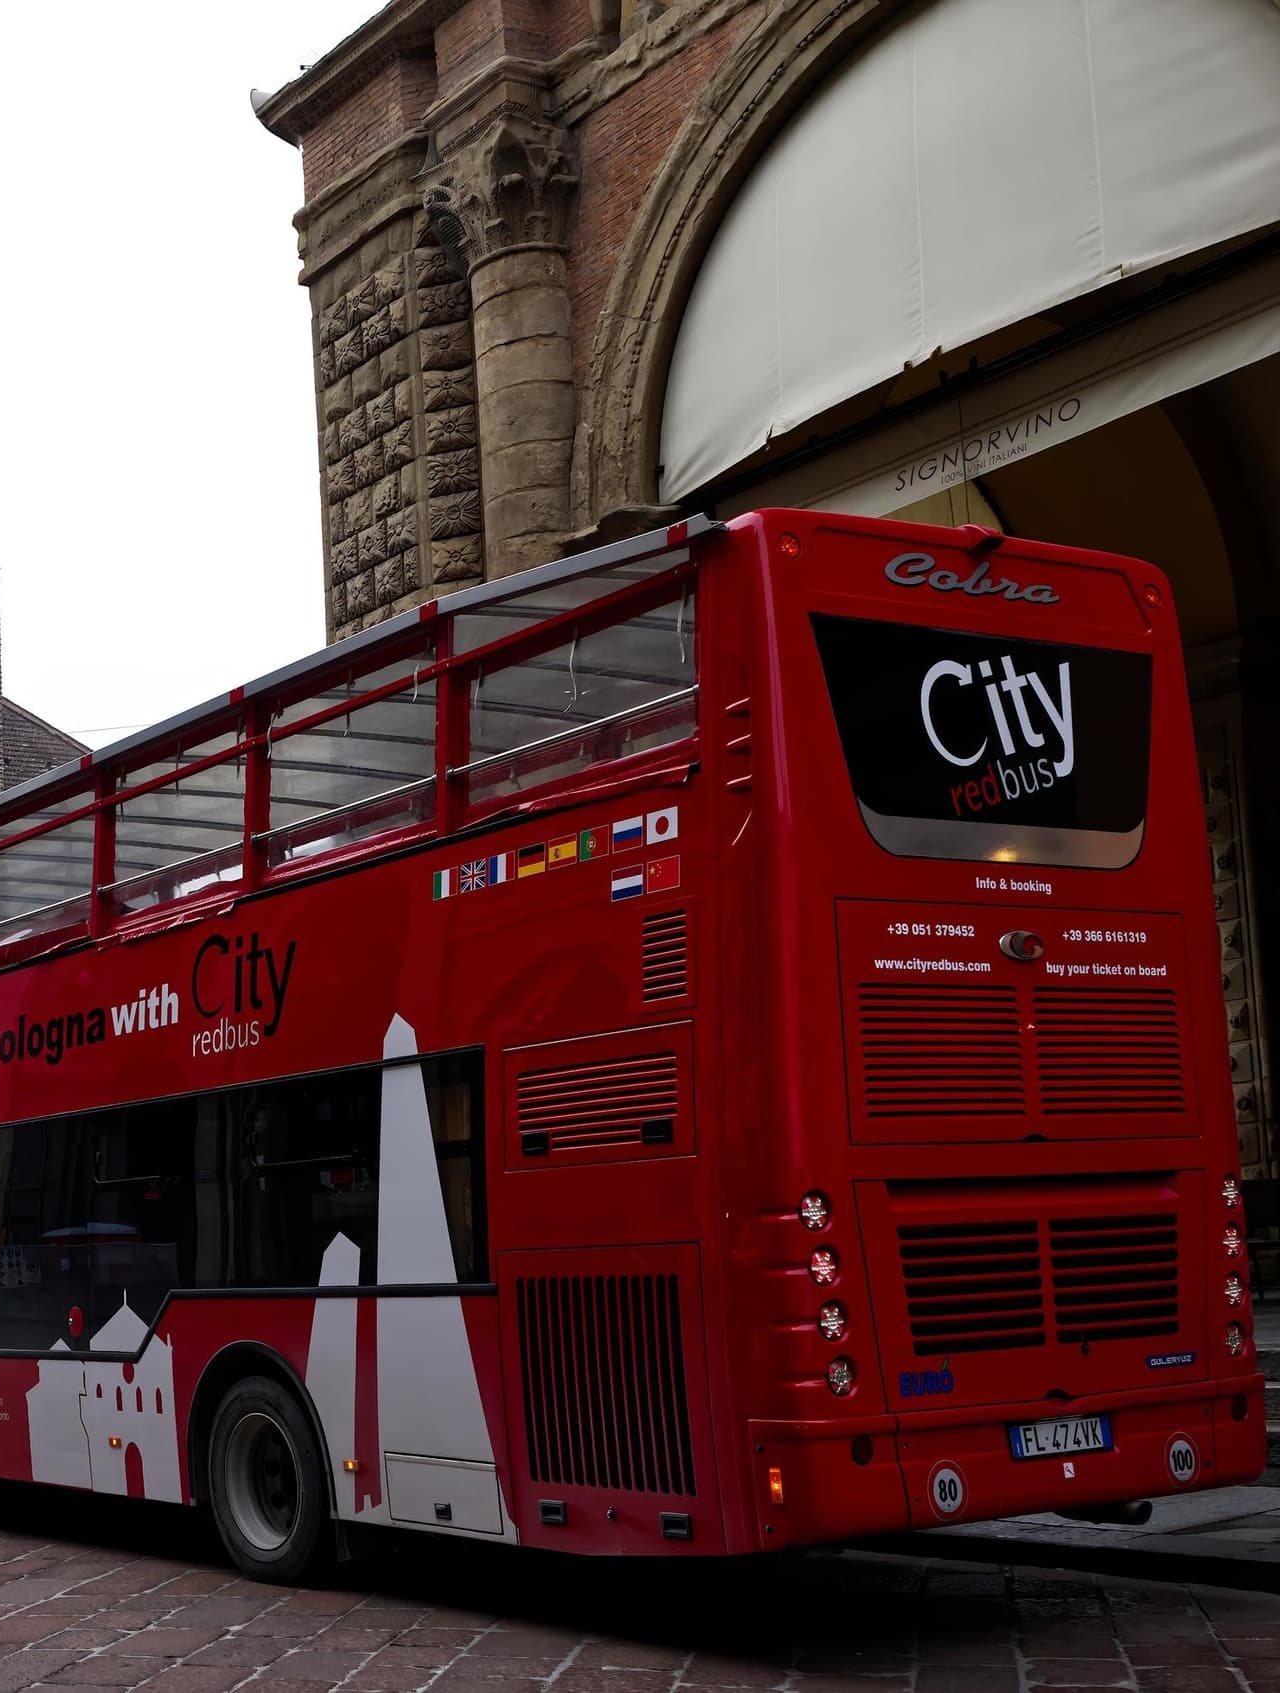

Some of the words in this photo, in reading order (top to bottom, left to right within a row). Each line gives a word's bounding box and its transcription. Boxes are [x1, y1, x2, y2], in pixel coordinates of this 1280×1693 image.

[894, 398, 1081, 492] SIGNORVINO
[967, 460, 986, 473] VINI
[988, 442, 1027, 466] ITALIANI
[884, 552, 1060, 604] Cobra
[920, 655, 1075, 778] City
[949, 757, 1055, 817] redbus
[975, 876, 997, 890] Info
[999, 878, 1008, 890] &
[1010, 879, 1052, 895] booking
[887, 923, 909, 935] +39
[911, 924, 932, 936] 051
[935, 925, 975, 937] 379452
[1062, 930, 1082, 942] +39
[1083, 930, 1103, 942] 366
[1105, 931, 1147, 943] 6161319
[874, 957, 991, 973] www.cityredbus.com
[1046, 962, 1063, 976] buy
[1067, 965, 1090, 977] your
[1092, 963, 1122, 975] ticket
[1124, 966, 1136, 976] on
[1138, 964, 1167, 977] board
[191, 932, 297, 1037] City
[111, 982, 179, 1038] with
[192, 1016, 261, 1058] redbus
[1171, 1448, 1193, 1472] 100
[938, 1478, 958, 1502] 80
